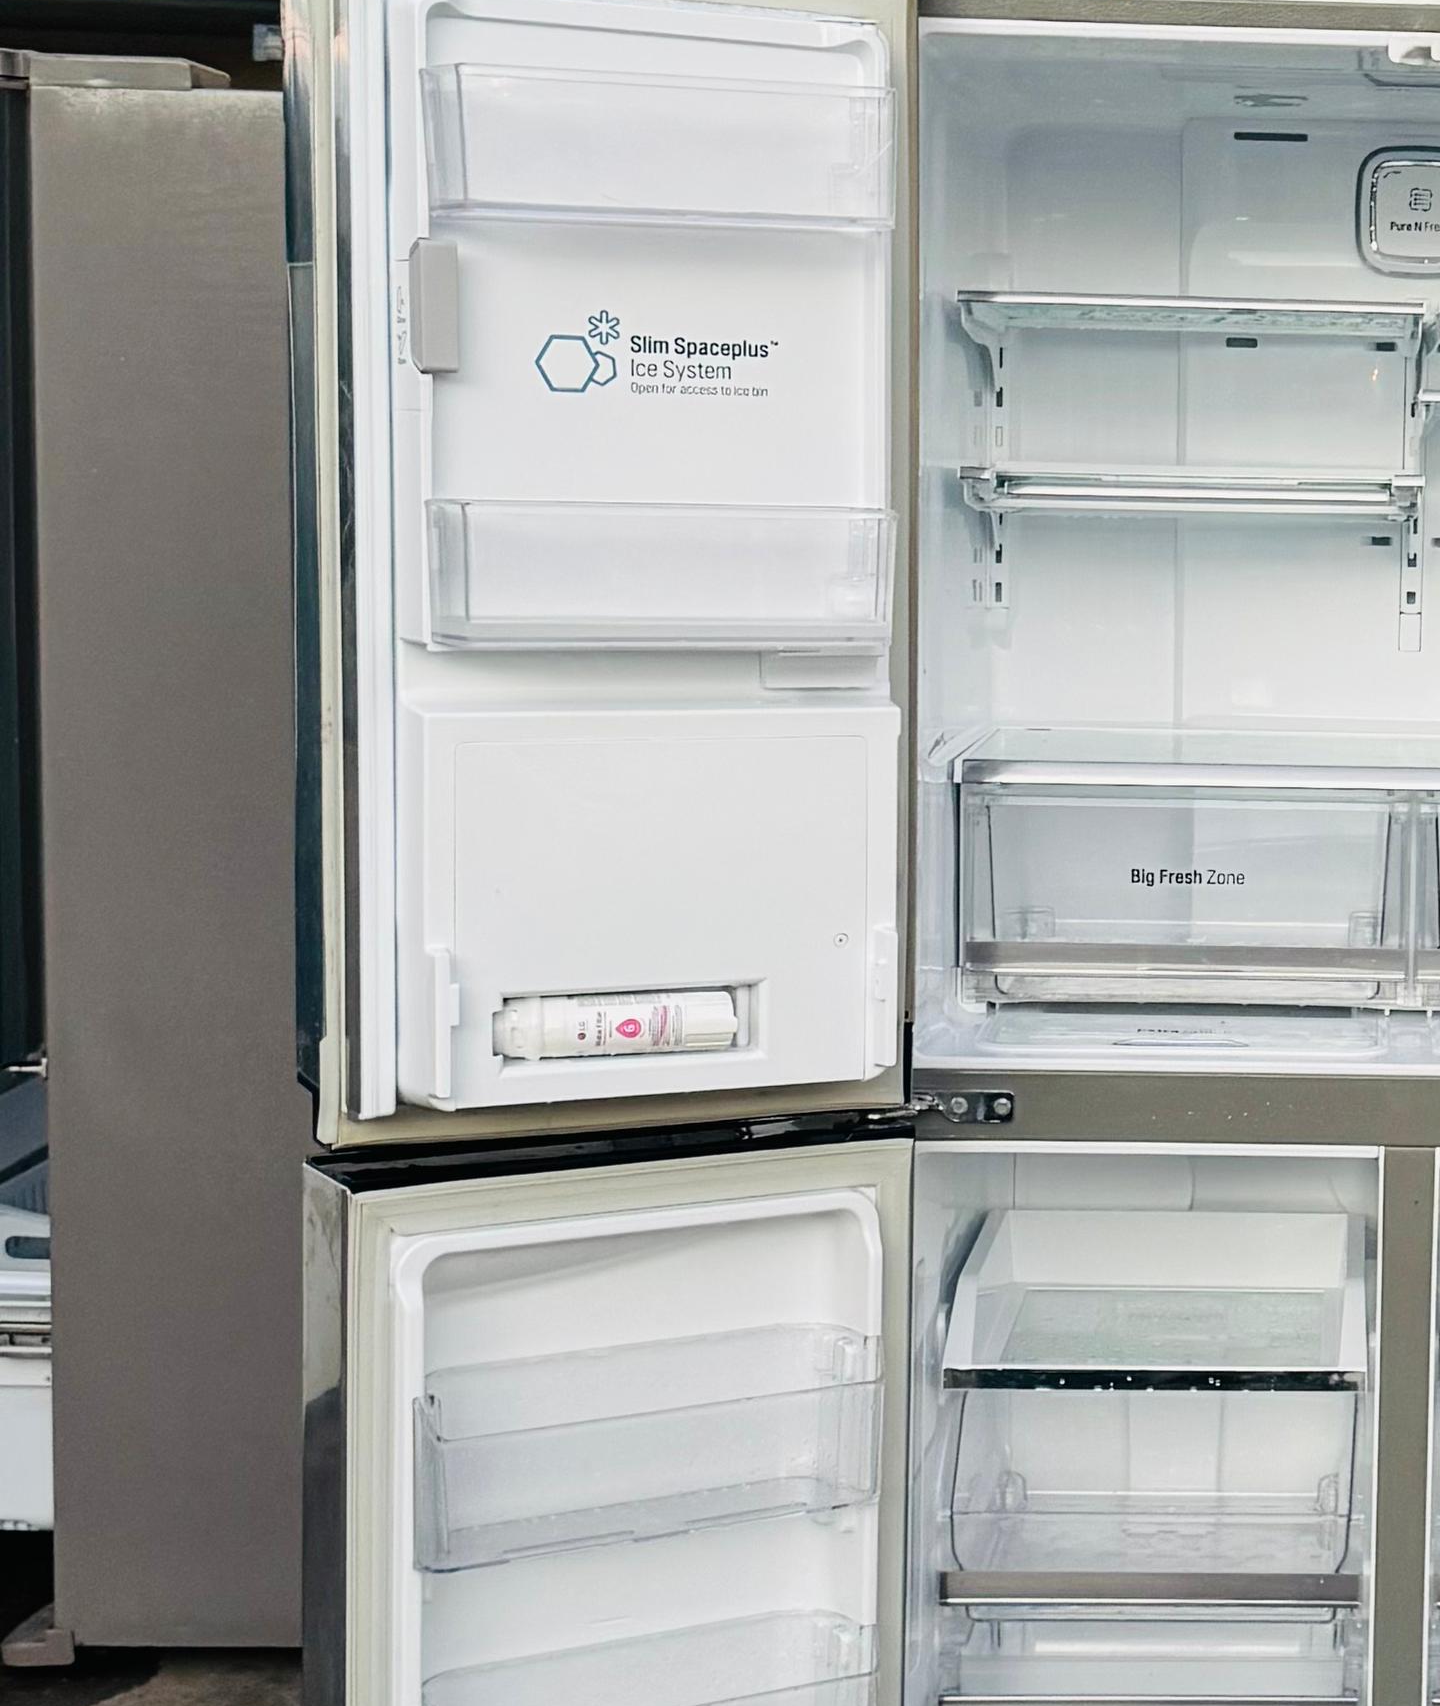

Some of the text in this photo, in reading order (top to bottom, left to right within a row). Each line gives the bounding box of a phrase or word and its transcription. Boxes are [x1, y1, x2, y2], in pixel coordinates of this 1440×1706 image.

[1390, 221, 1412, 231] Pure
[1414, 221, 1422, 231] N
[630, 335, 669, 354] Slim
[630, 359, 732, 382] Ice System
[631, 382, 659, 395] Open
[662, 383, 676, 394] for
[680, 385, 718, 396] access
[721, 386, 732, 396] to
[752, 386, 768, 397] bin
[1131, 868, 1245, 887] Big Fresh Zone
